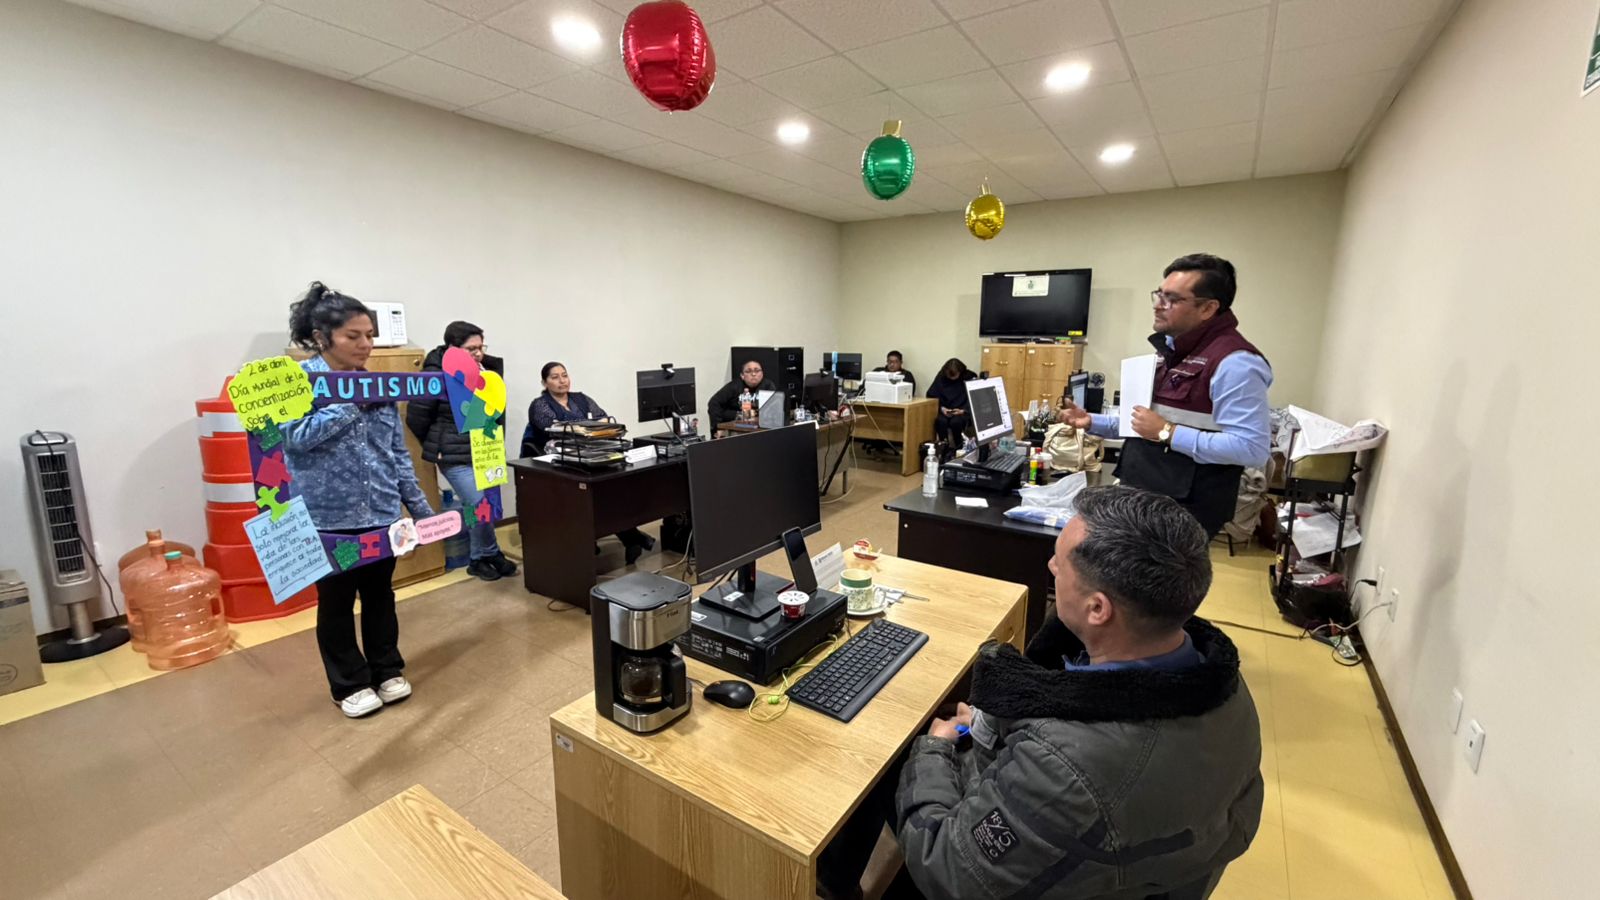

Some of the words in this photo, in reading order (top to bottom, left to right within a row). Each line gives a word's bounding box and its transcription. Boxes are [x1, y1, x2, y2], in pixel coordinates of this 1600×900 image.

[246, 363, 257, 376] 2
[257, 362, 269, 373] de
[269, 357, 288, 370] abril
[229, 384, 250, 399] Día
[284, 372, 294, 384] de
[313, 375, 442, 399] AUTISMO
[278, 405, 288, 416] el
